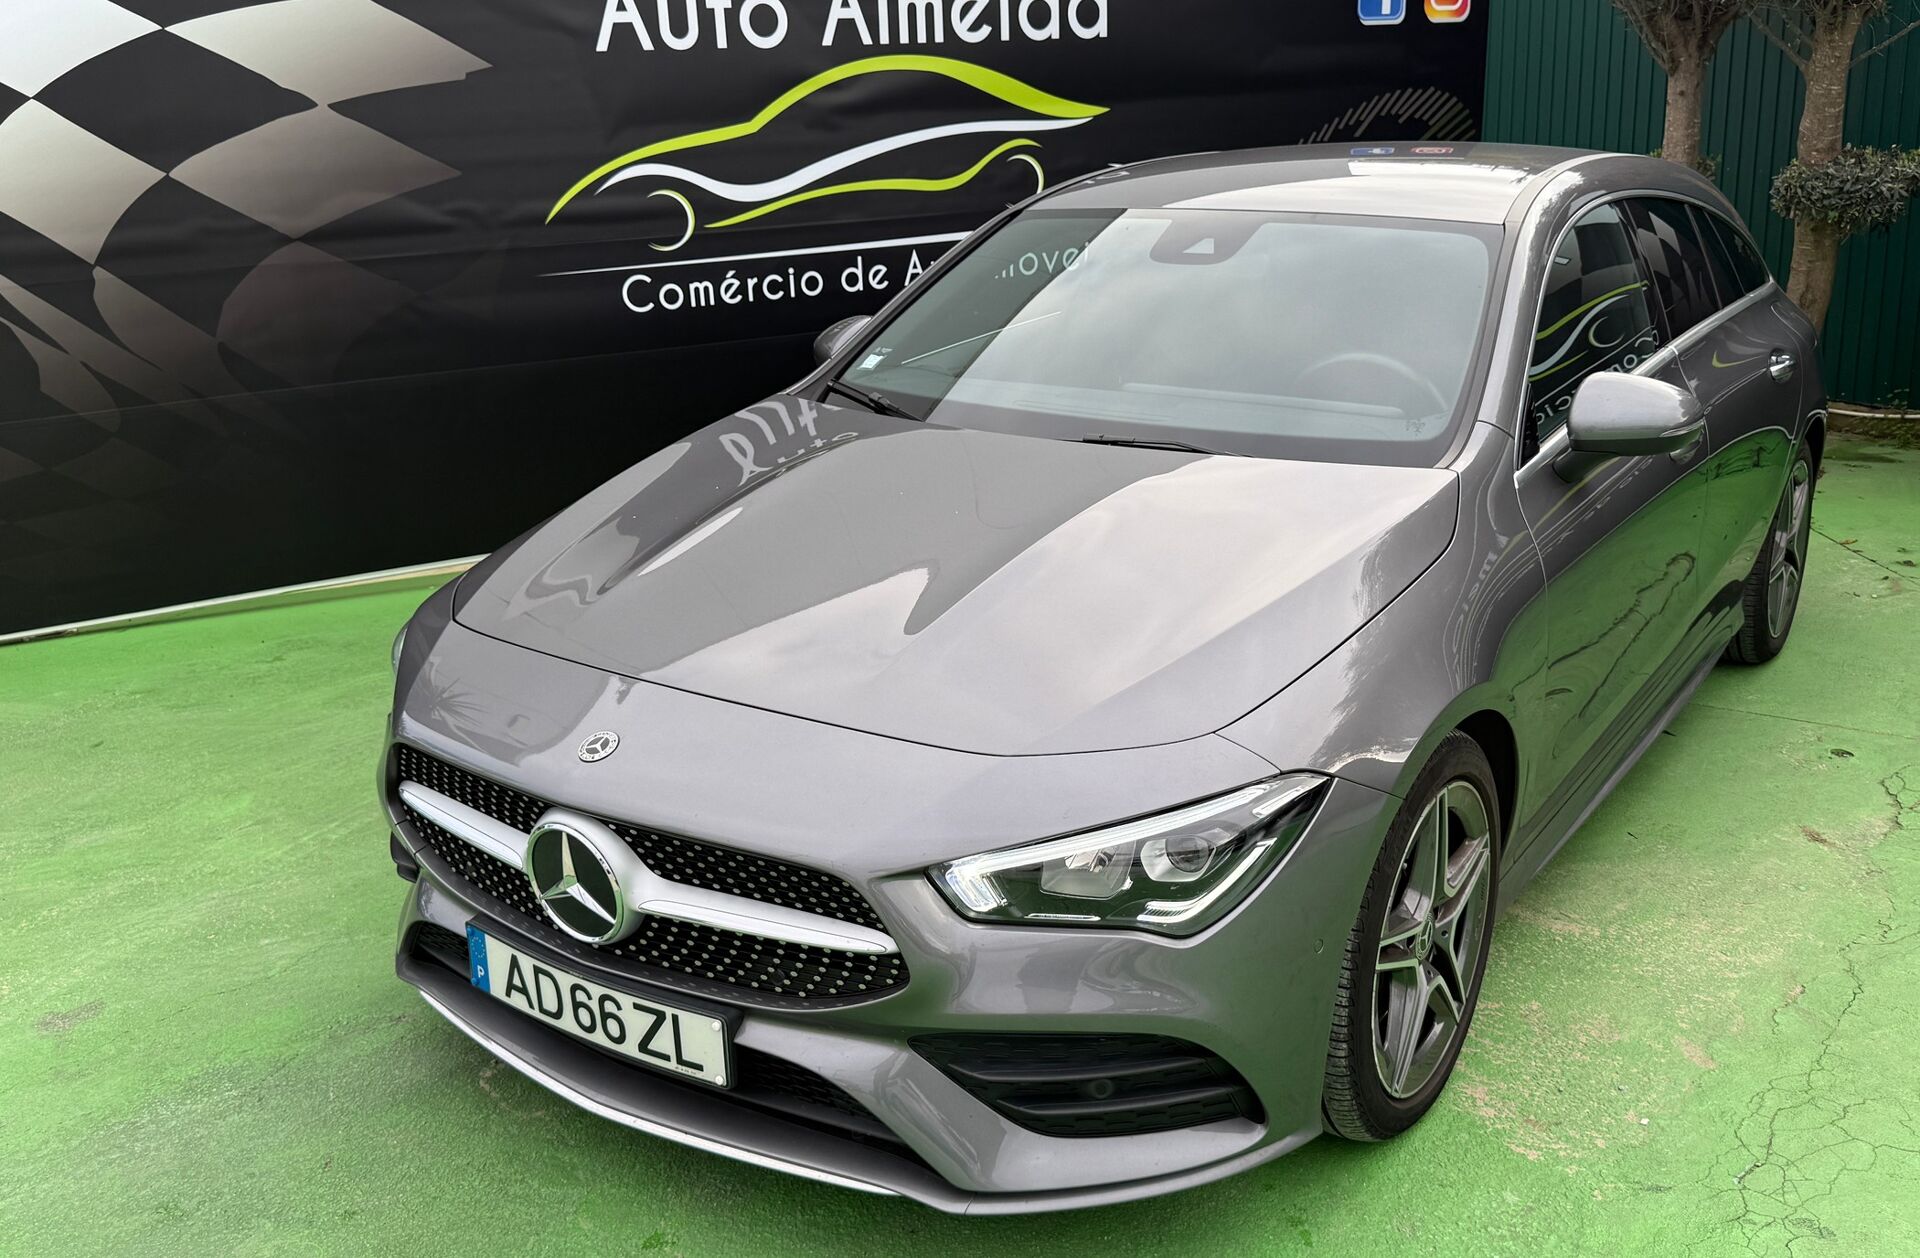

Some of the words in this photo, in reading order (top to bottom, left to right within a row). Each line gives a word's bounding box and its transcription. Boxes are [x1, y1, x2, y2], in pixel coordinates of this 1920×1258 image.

[622, 267, 824, 313] Comércio
[840, 255, 889, 292] de
[477, 965, 485, 978] P
